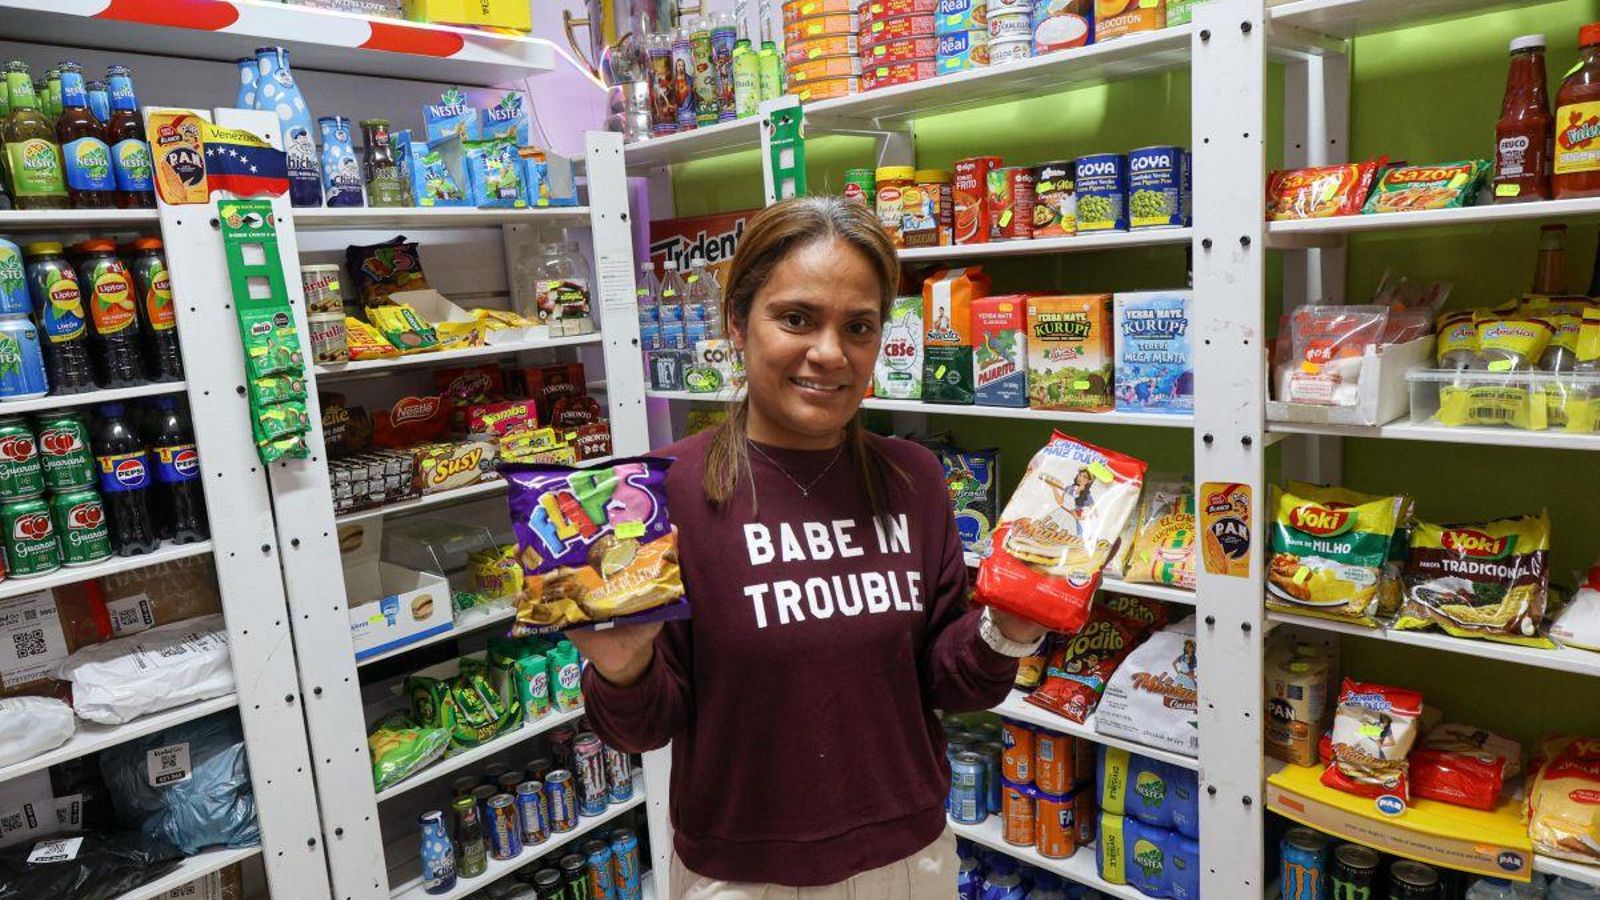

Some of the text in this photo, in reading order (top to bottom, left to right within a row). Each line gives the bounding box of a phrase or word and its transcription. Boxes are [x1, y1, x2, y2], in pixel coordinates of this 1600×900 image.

[942, 38, 965, 54] Real
[431, 104, 469, 119] NESTEA
[488, 107, 523, 121] NESTEA
[77, 157, 108, 167] NESTEA
[1078, 162, 1116, 177] GOYA
[1132, 155, 1170, 170] GOYA
[100, 284, 126, 294] Lipton
[156, 282, 170, 291] Lip
[577, 434, 610, 444] TORONTO
[41, 456, 86, 474] Guaraná
[176, 460, 199, 470] PEPS
[434, 447, 482, 483] Susy
[117, 468, 144, 478] PEPSI
[1296, 508, 1341, 530] Yoki
[743, 513, 912, 566] BABE IN
[1313, 539, 1352, 555] MILHO
[1449, 531, 1501, 555] Yoki
[1442, 558, 1530, 580] TRADICIONAL
[743, 570, 923, 629] TROUBLE
[1170, 700, 1197, 710] Casab
